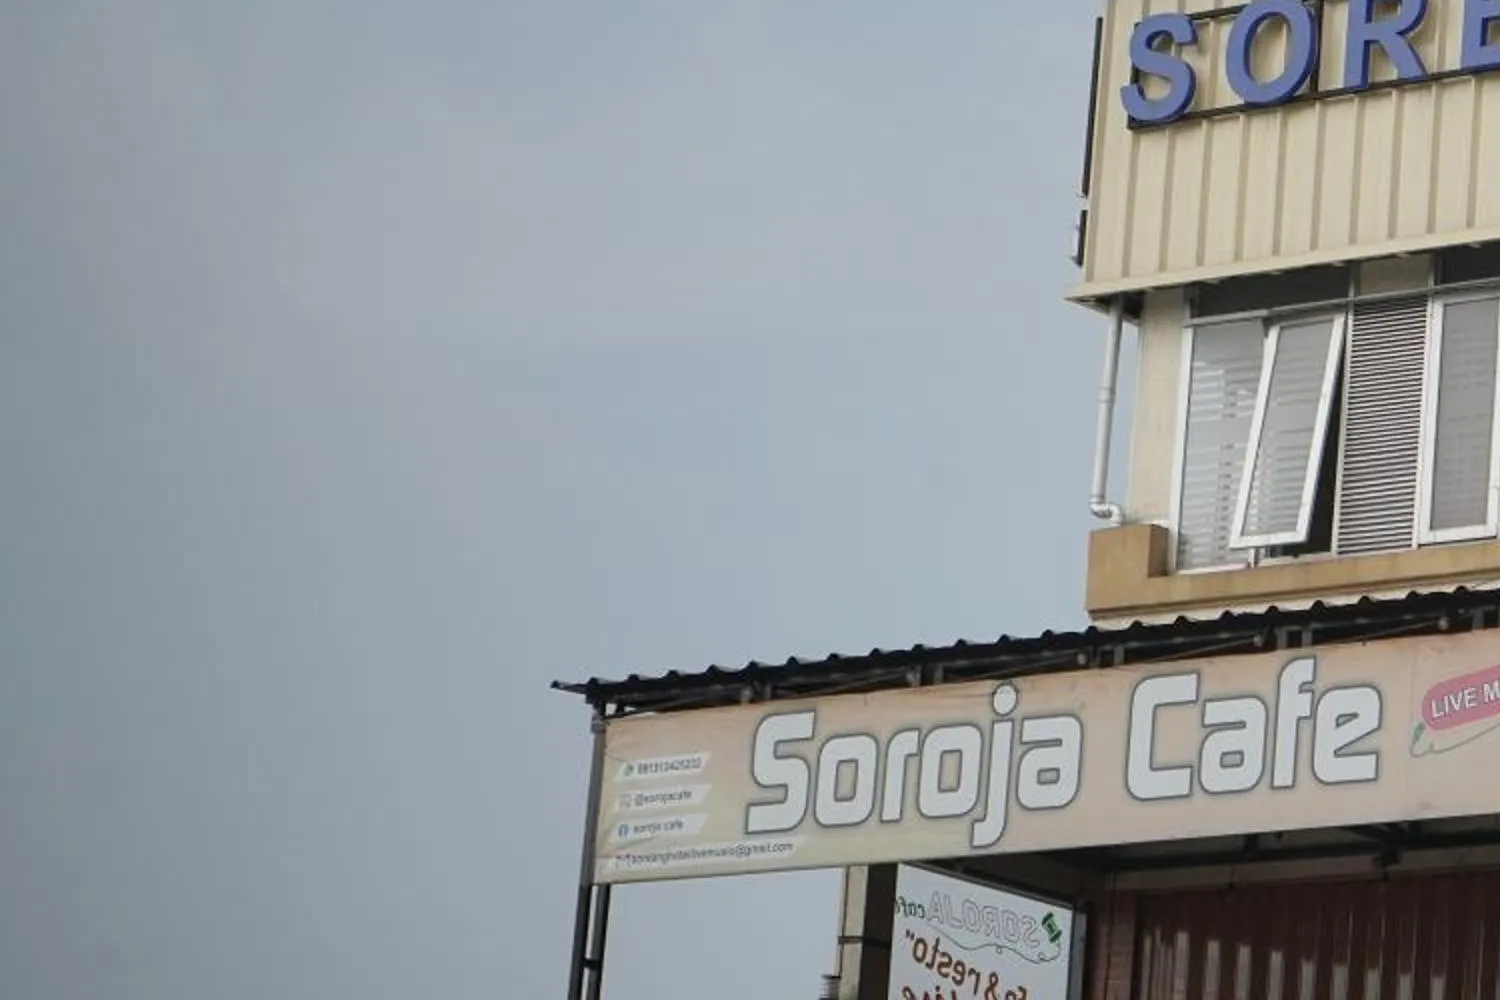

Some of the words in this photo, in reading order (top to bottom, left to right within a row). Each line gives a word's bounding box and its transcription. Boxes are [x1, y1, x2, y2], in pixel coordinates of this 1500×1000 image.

[745, 684, 1083, 849] Soroja
[1126, 657, 1382, 800] Cafe
[1431, 687, 1478, 718] LIVE
